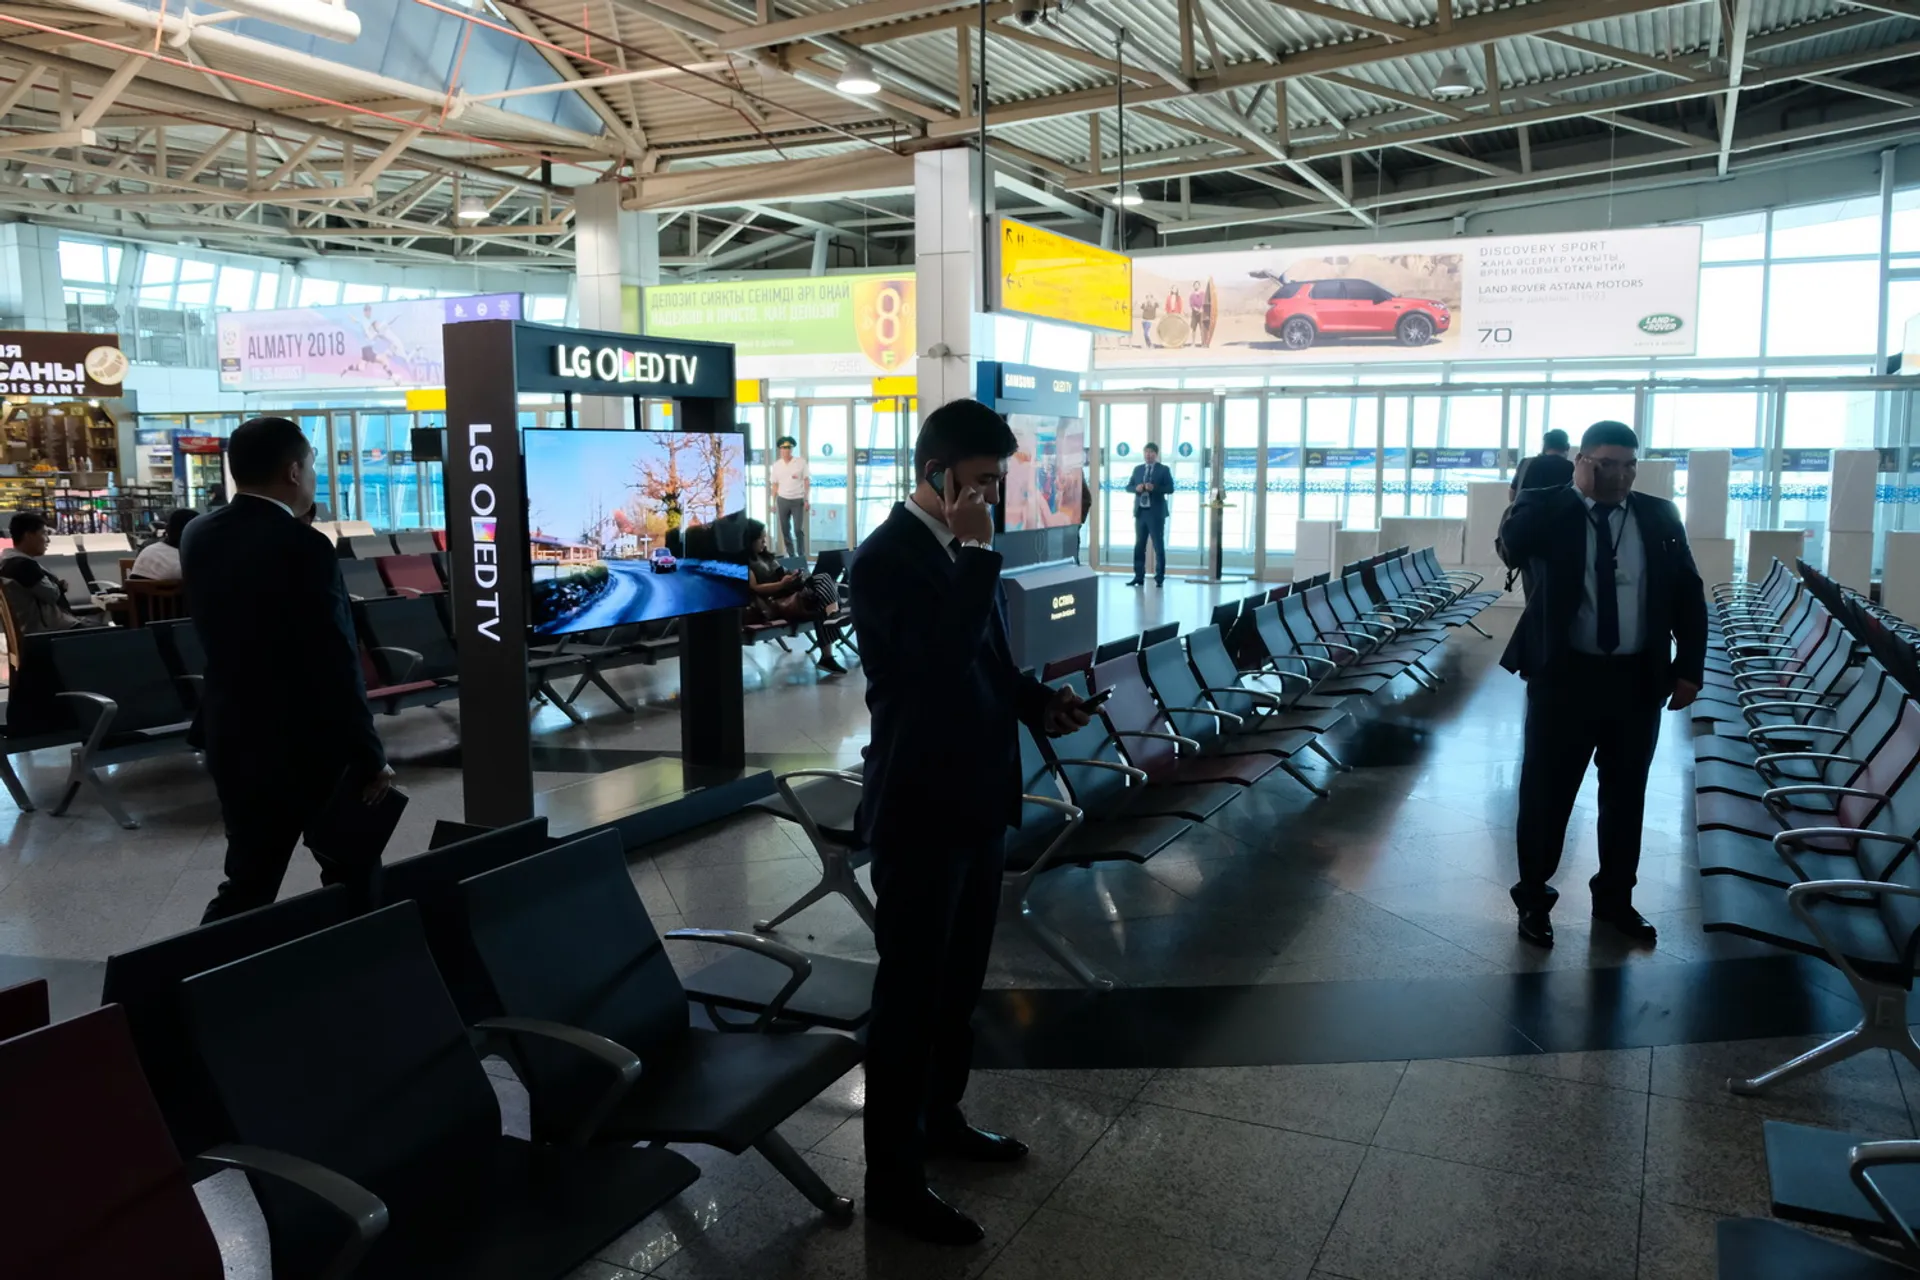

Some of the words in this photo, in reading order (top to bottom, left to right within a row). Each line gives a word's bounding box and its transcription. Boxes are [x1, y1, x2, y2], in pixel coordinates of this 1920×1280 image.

[1480, 243, 1556, 257] DISCOVERY
[1561, 240, 1607, 254] SPORT
[1478, 284, 1508, 295] LAND
[1511, 282, 1546, 293] ROVER
[1549, 280, 1593, 292] ASTANA
[1596, 279, 1644, 290] MOTORS
[651, 291, 697, 309] ДЕПОЗИТ
[248, 334, 303, 360] ALMATY
[307, 331, 346, 357] 2018
[1477, 326, 1513, 343] 70
[558, 344, 591, 379] LG
[596, 347, 665, 383] OLED
[665, 353, 698, 385] TV
[468, 424, 494, 472] LG
[476, 592, 501, 642] TV
